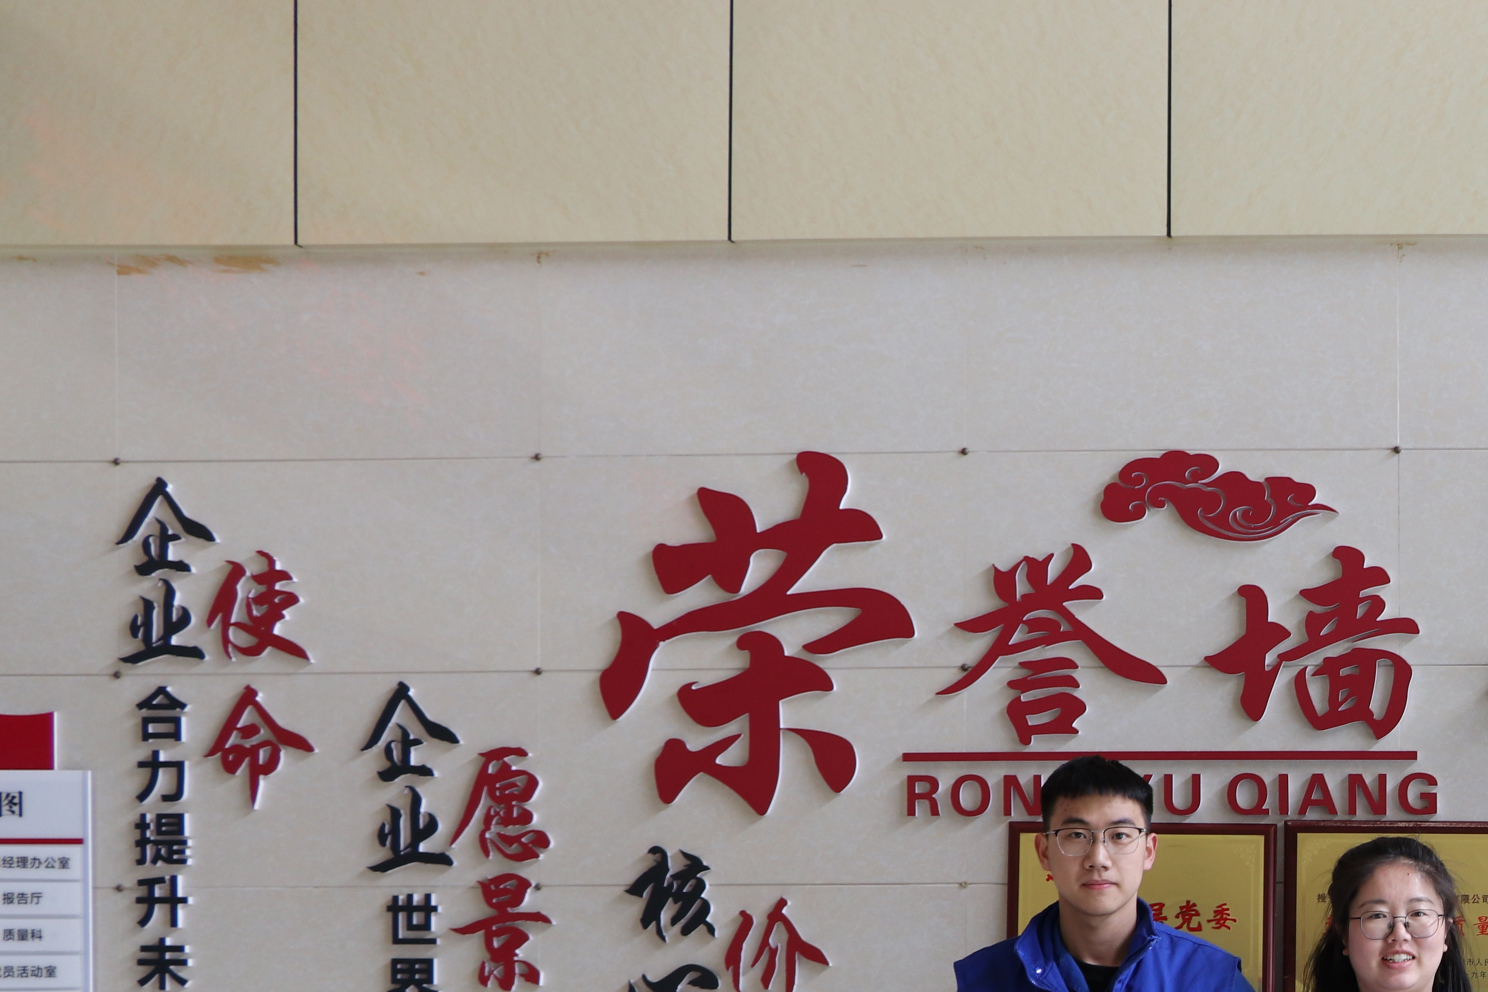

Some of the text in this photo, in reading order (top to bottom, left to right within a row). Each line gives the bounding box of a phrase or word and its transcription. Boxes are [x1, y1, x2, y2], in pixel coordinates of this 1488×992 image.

[116, 477, 218, 664] 企业
[204, 550, 316, 810] 使命
[600, 451, 1421, 816] 荣誉墙
[360, 681, 460, 872] 企业
[906, 773, 1043, 817] RON
[1226, 772, 1439, 817] QIANG
[2, 856, 71, 870] 经理办公室
[2, 891, 43, 905] 报告厅
[450, 746, 555, 991] 愿景
[0, 965, 57, 979] 员活动室
[3, 928, 43, 942] 质量科
